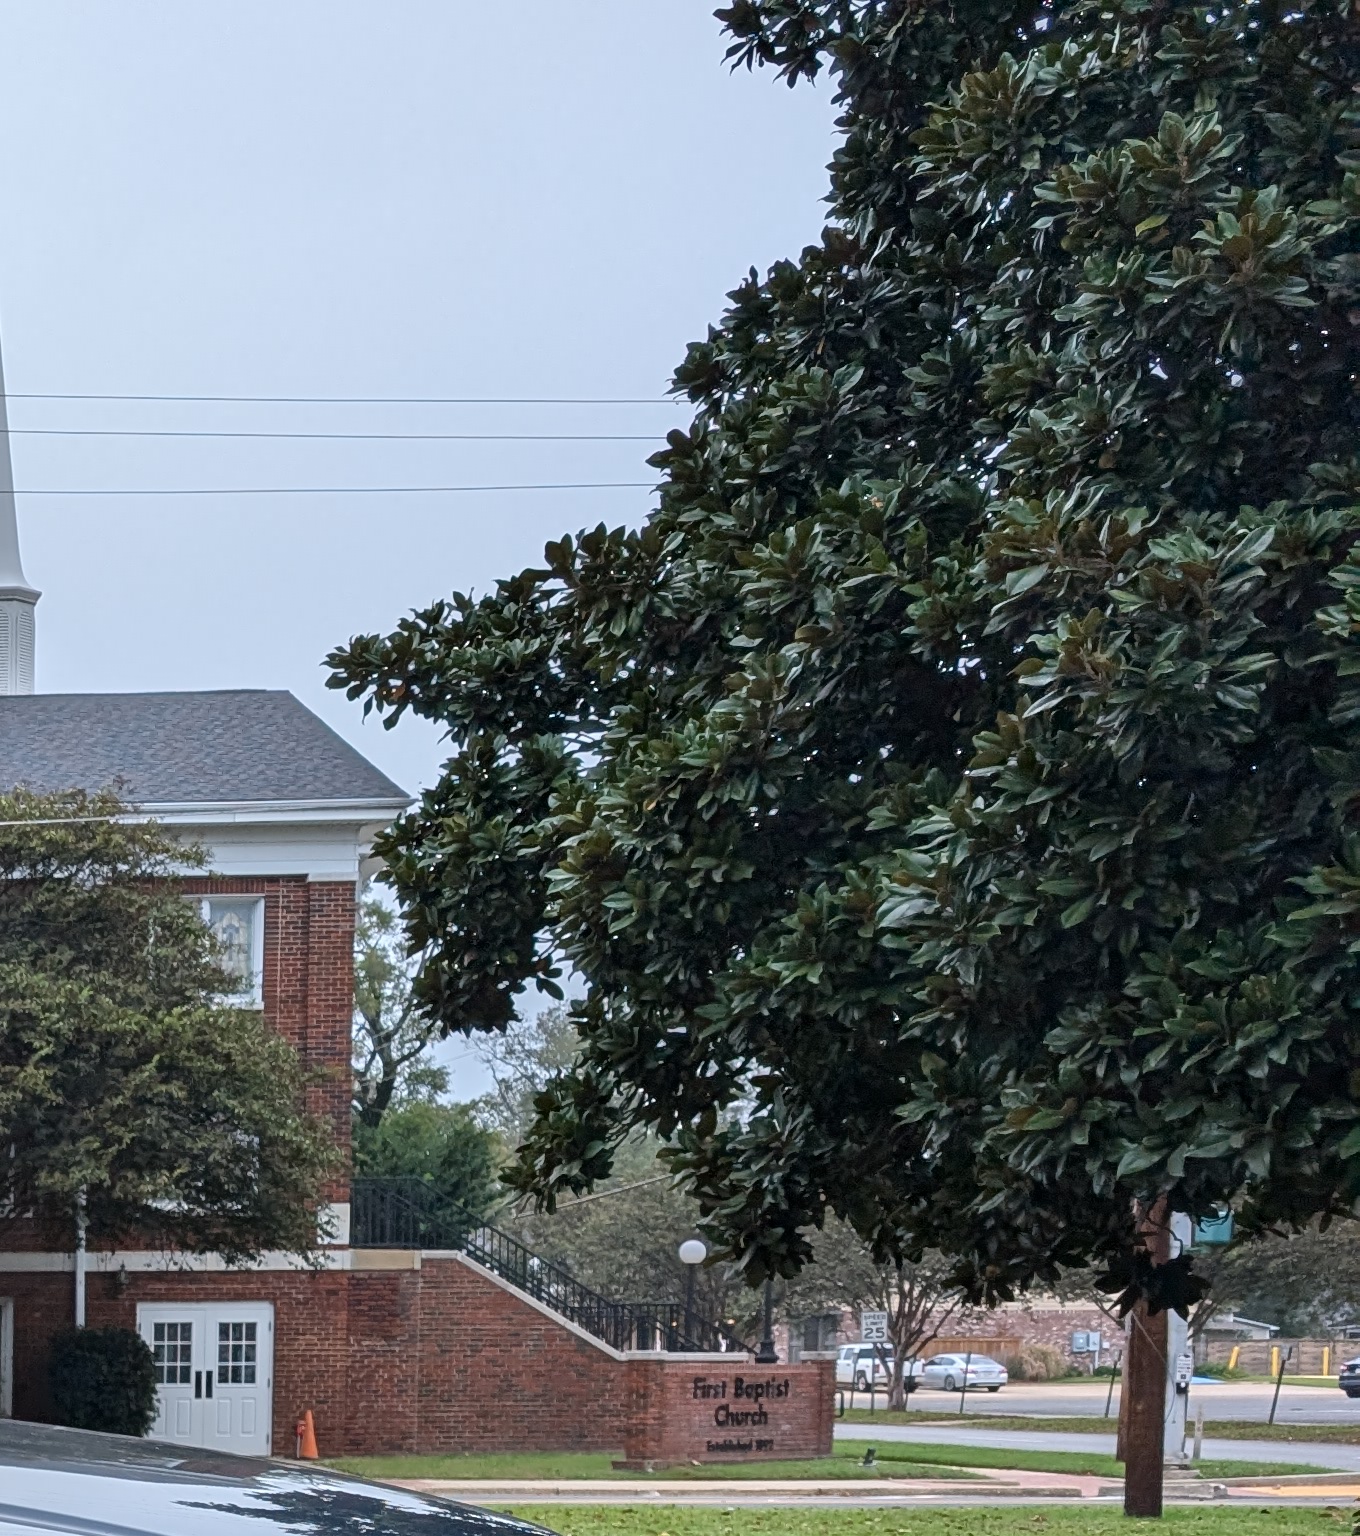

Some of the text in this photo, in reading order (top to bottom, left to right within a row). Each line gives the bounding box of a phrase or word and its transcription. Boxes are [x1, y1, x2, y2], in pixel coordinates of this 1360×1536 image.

[864, 1327, 885, 1339] 25
[693, 1376, 790, 1402] First Baptist
[715, 1404, 768, 1426] Church
